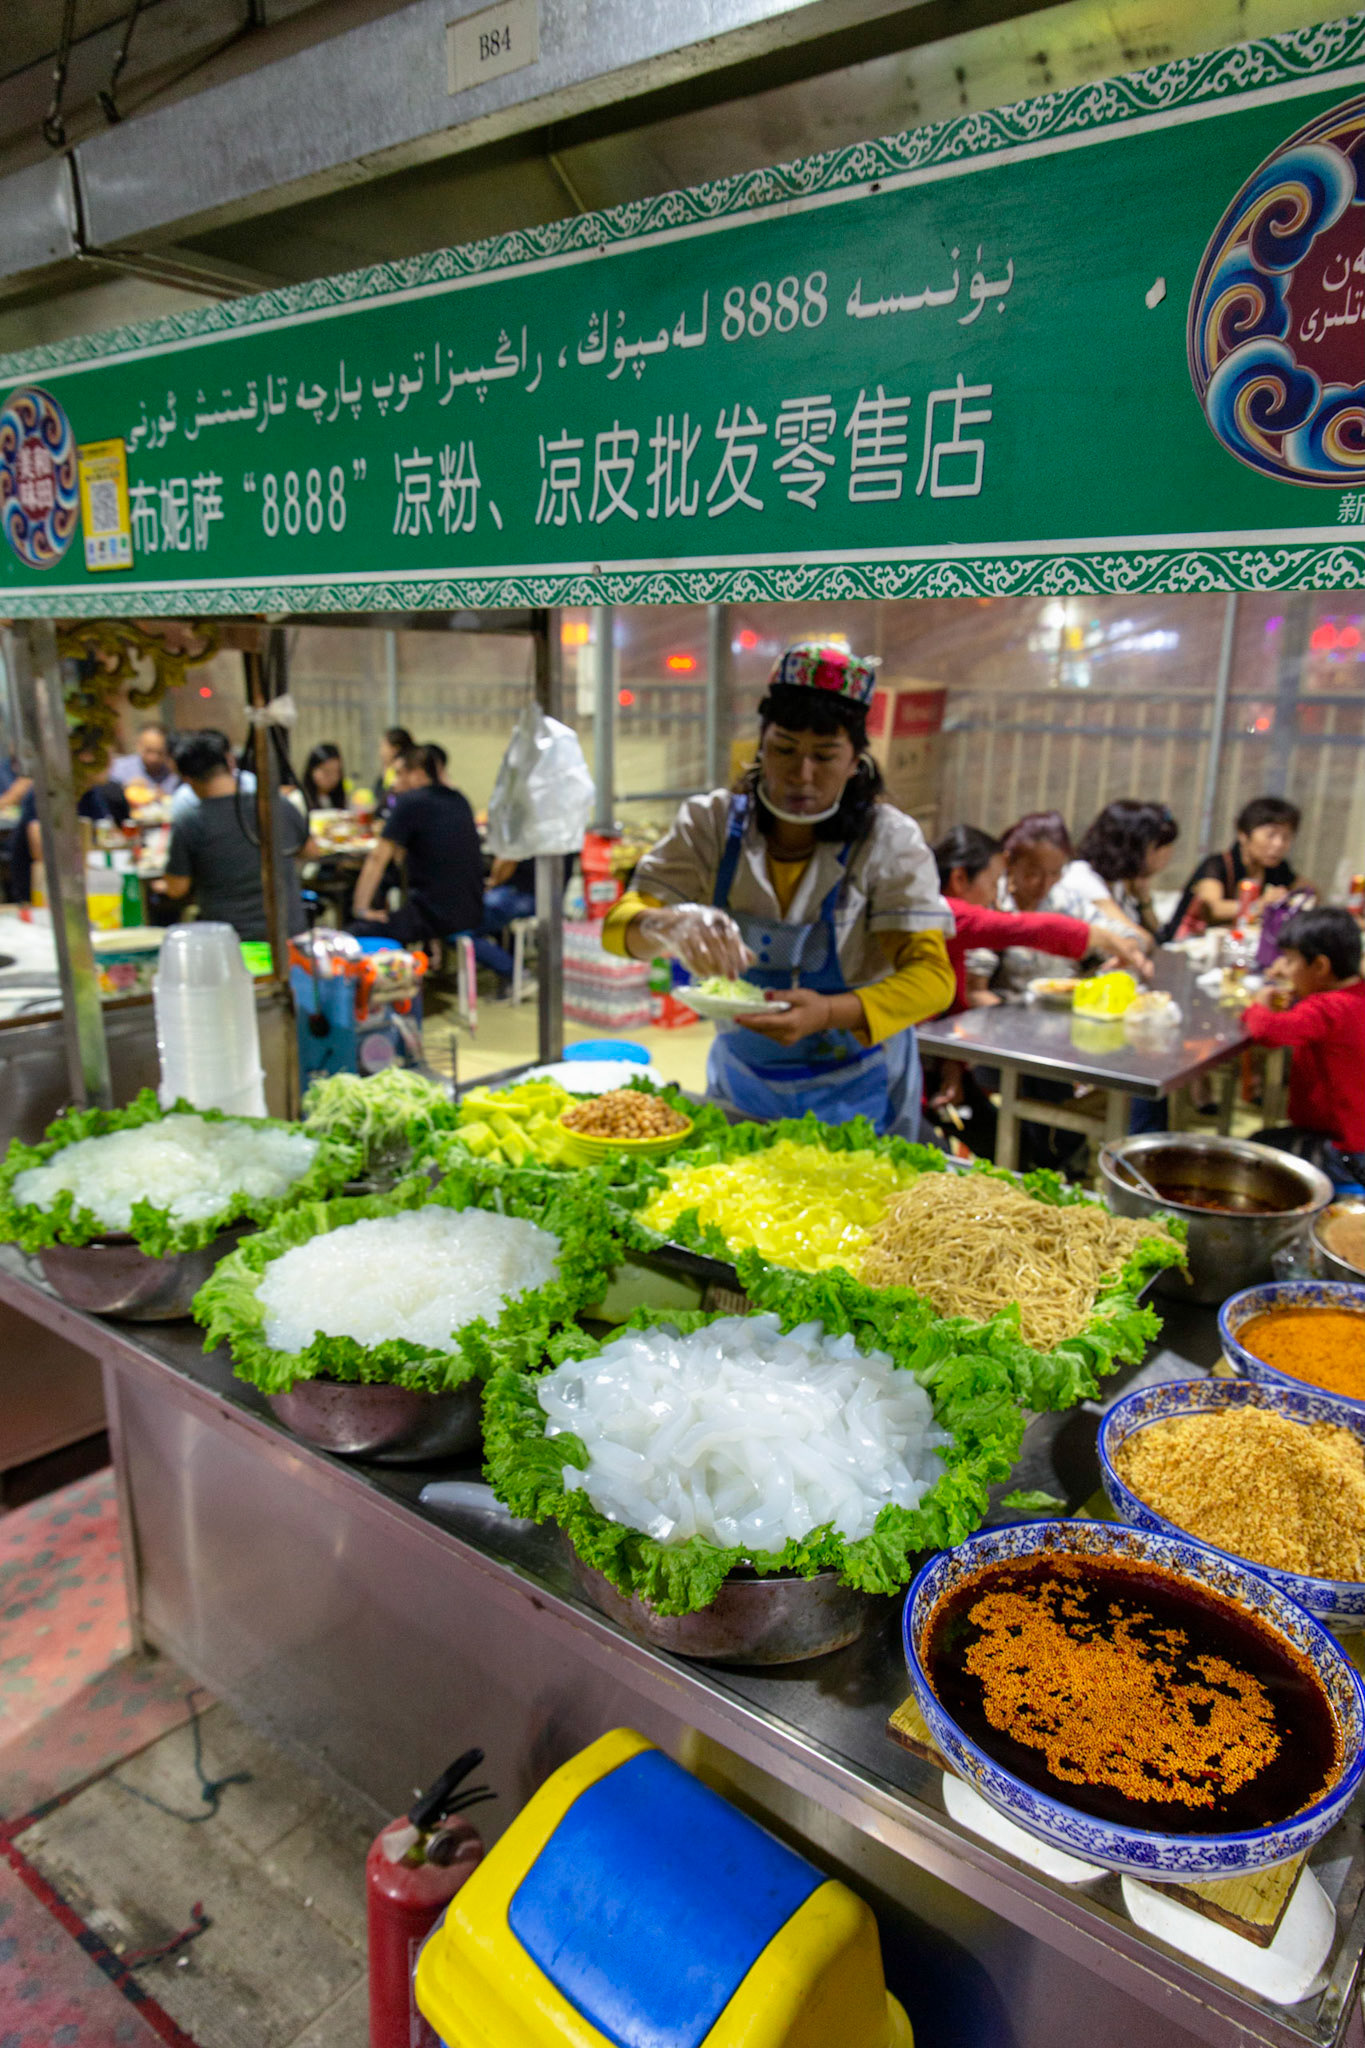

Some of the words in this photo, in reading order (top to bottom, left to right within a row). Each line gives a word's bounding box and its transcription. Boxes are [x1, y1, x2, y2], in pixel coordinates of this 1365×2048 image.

[479, 25, 512, 61] B84
[720, 271, 828, 342] 8888
[372, 351, 425, 416] توپ
